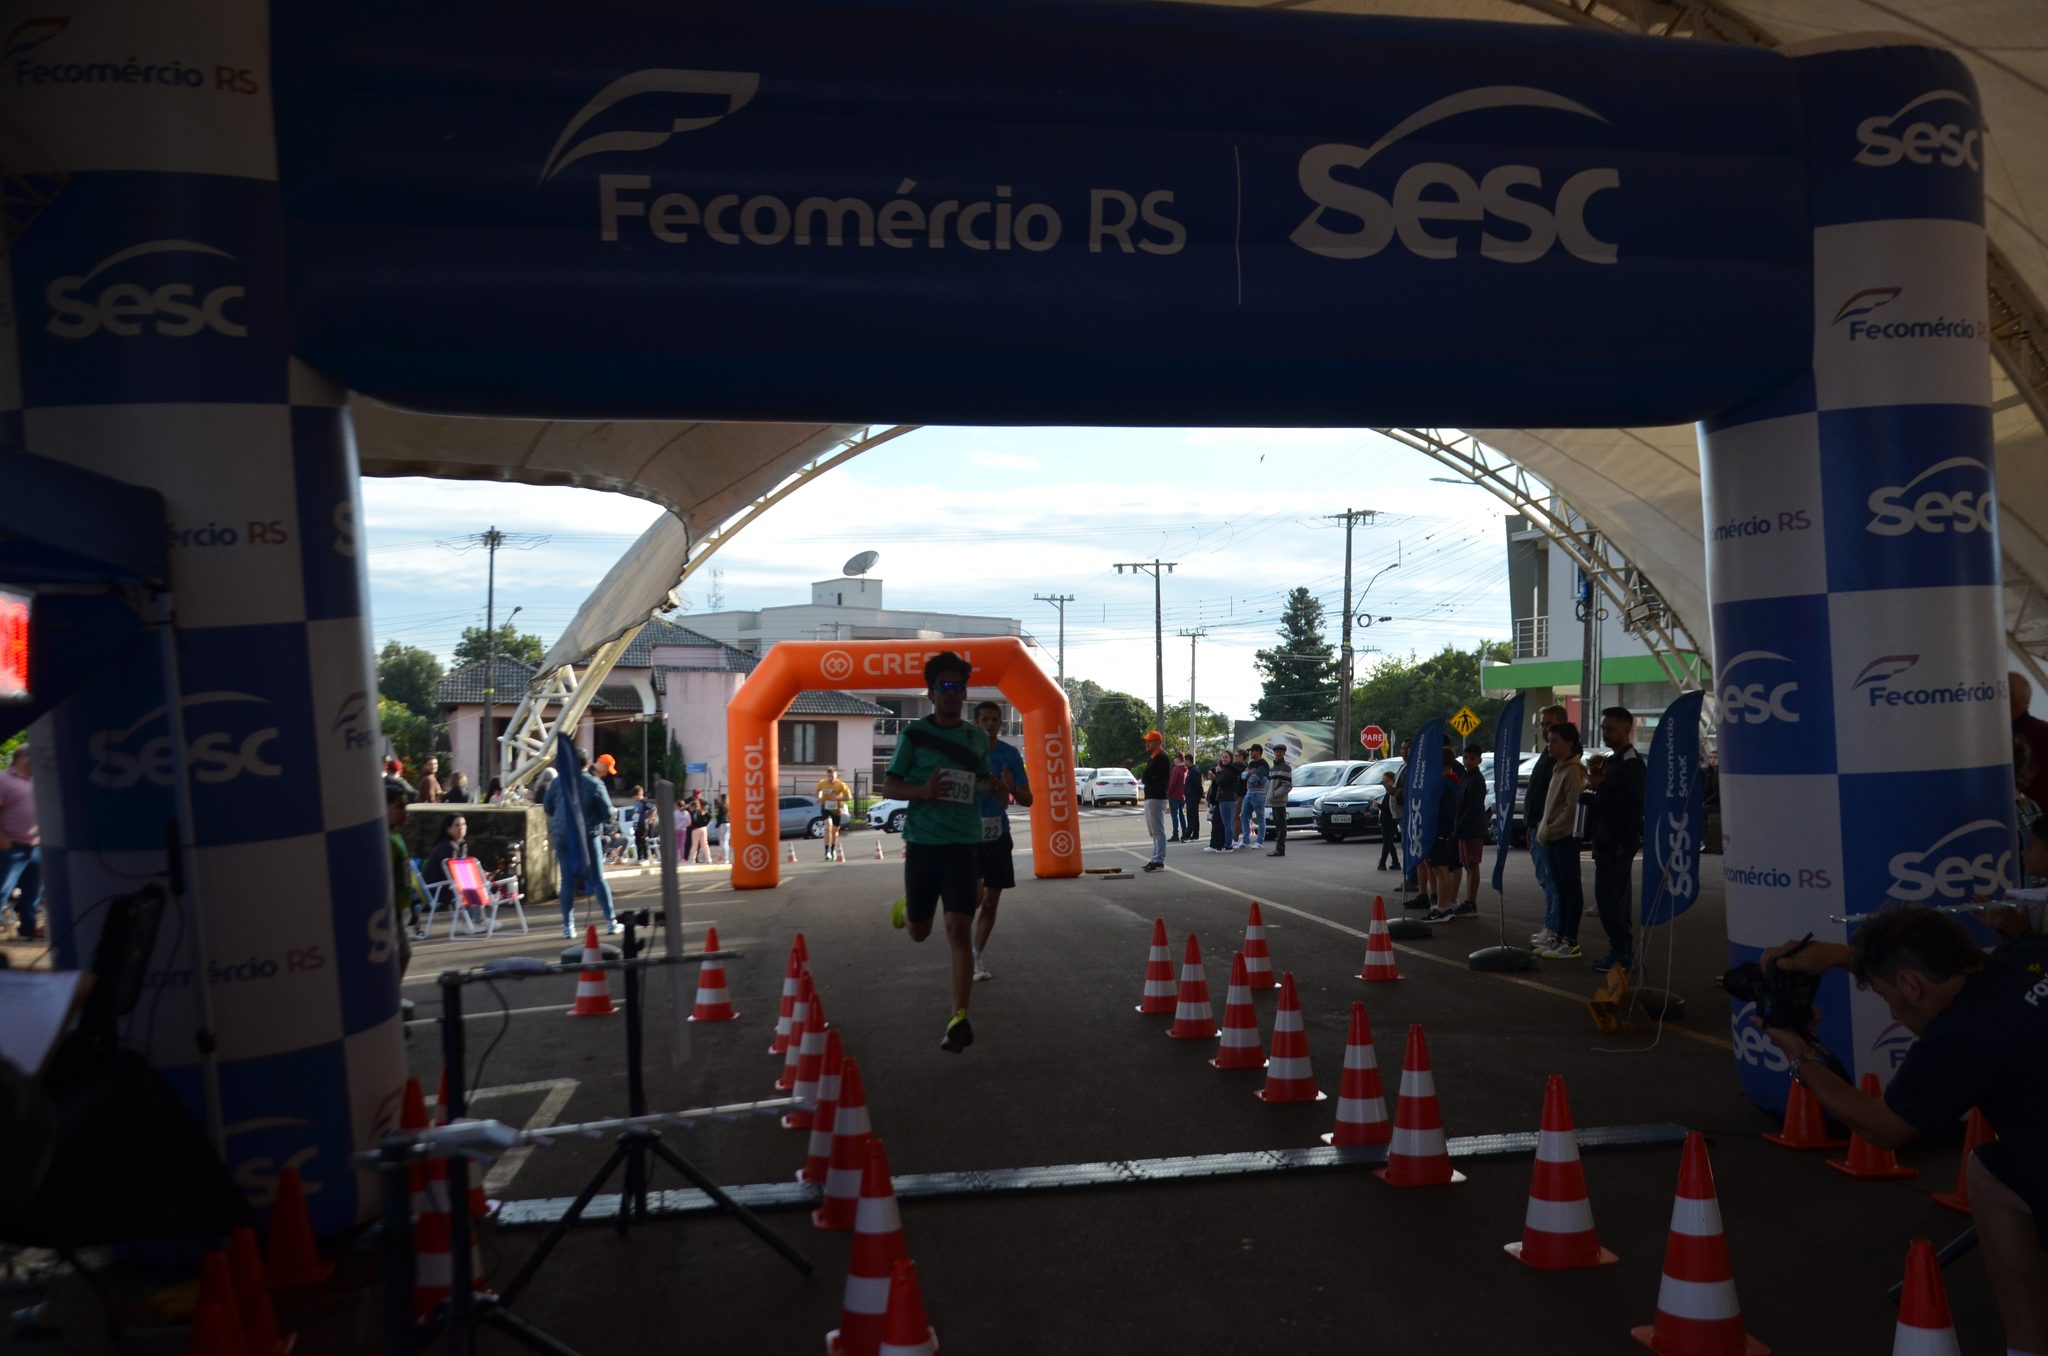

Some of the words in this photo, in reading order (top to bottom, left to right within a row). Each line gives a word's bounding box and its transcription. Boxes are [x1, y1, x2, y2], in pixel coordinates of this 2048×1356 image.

[15, 56, 205, 87] Fecomércio
[215, 65, 258, 95] RS
[599, 174, 1062, 252] Fecomércio
[1089, 189, 1187, 255] RS
[1849, 316, 1975, 341] Fecomércio
[248, 520, 288, 544] RS
[1778, 510, 1812, 531] RS
[1869, 682, 1995, 706] Fecomércio
[1362, 733, 1384, 742] PARE
[744, 736, 766, 835] CRESOL
[1045, 725, 1067, 823] CRESOL
[1798, 869, 1832, 889] RS
[287, 946, 326, 975] RS
